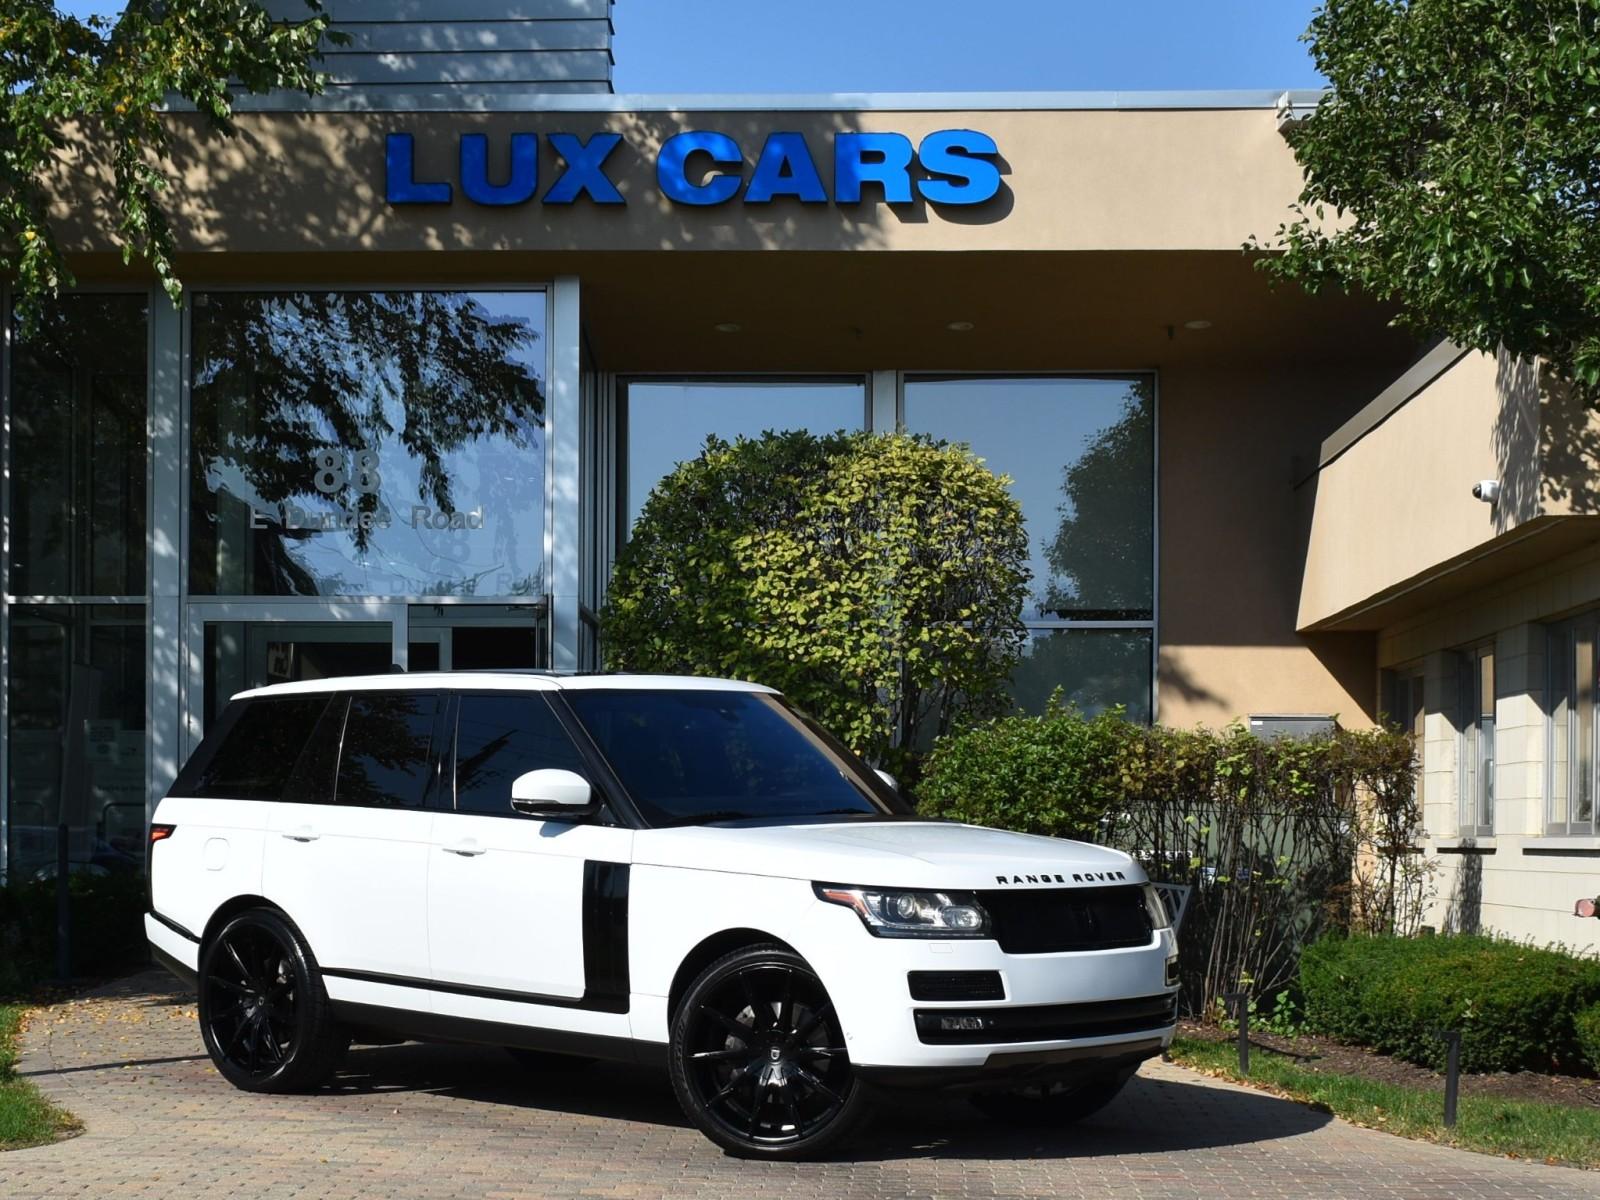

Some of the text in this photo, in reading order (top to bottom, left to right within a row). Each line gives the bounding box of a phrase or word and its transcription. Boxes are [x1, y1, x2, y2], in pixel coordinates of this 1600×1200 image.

[385, 129, 1003, 207] LUX CARS
[314, 449, 380, 494] 88
[250, 506, 268, 529] E
[411, 505, 485, 530] Road
[995, 871, 1126, 885] RANGE ROVER
